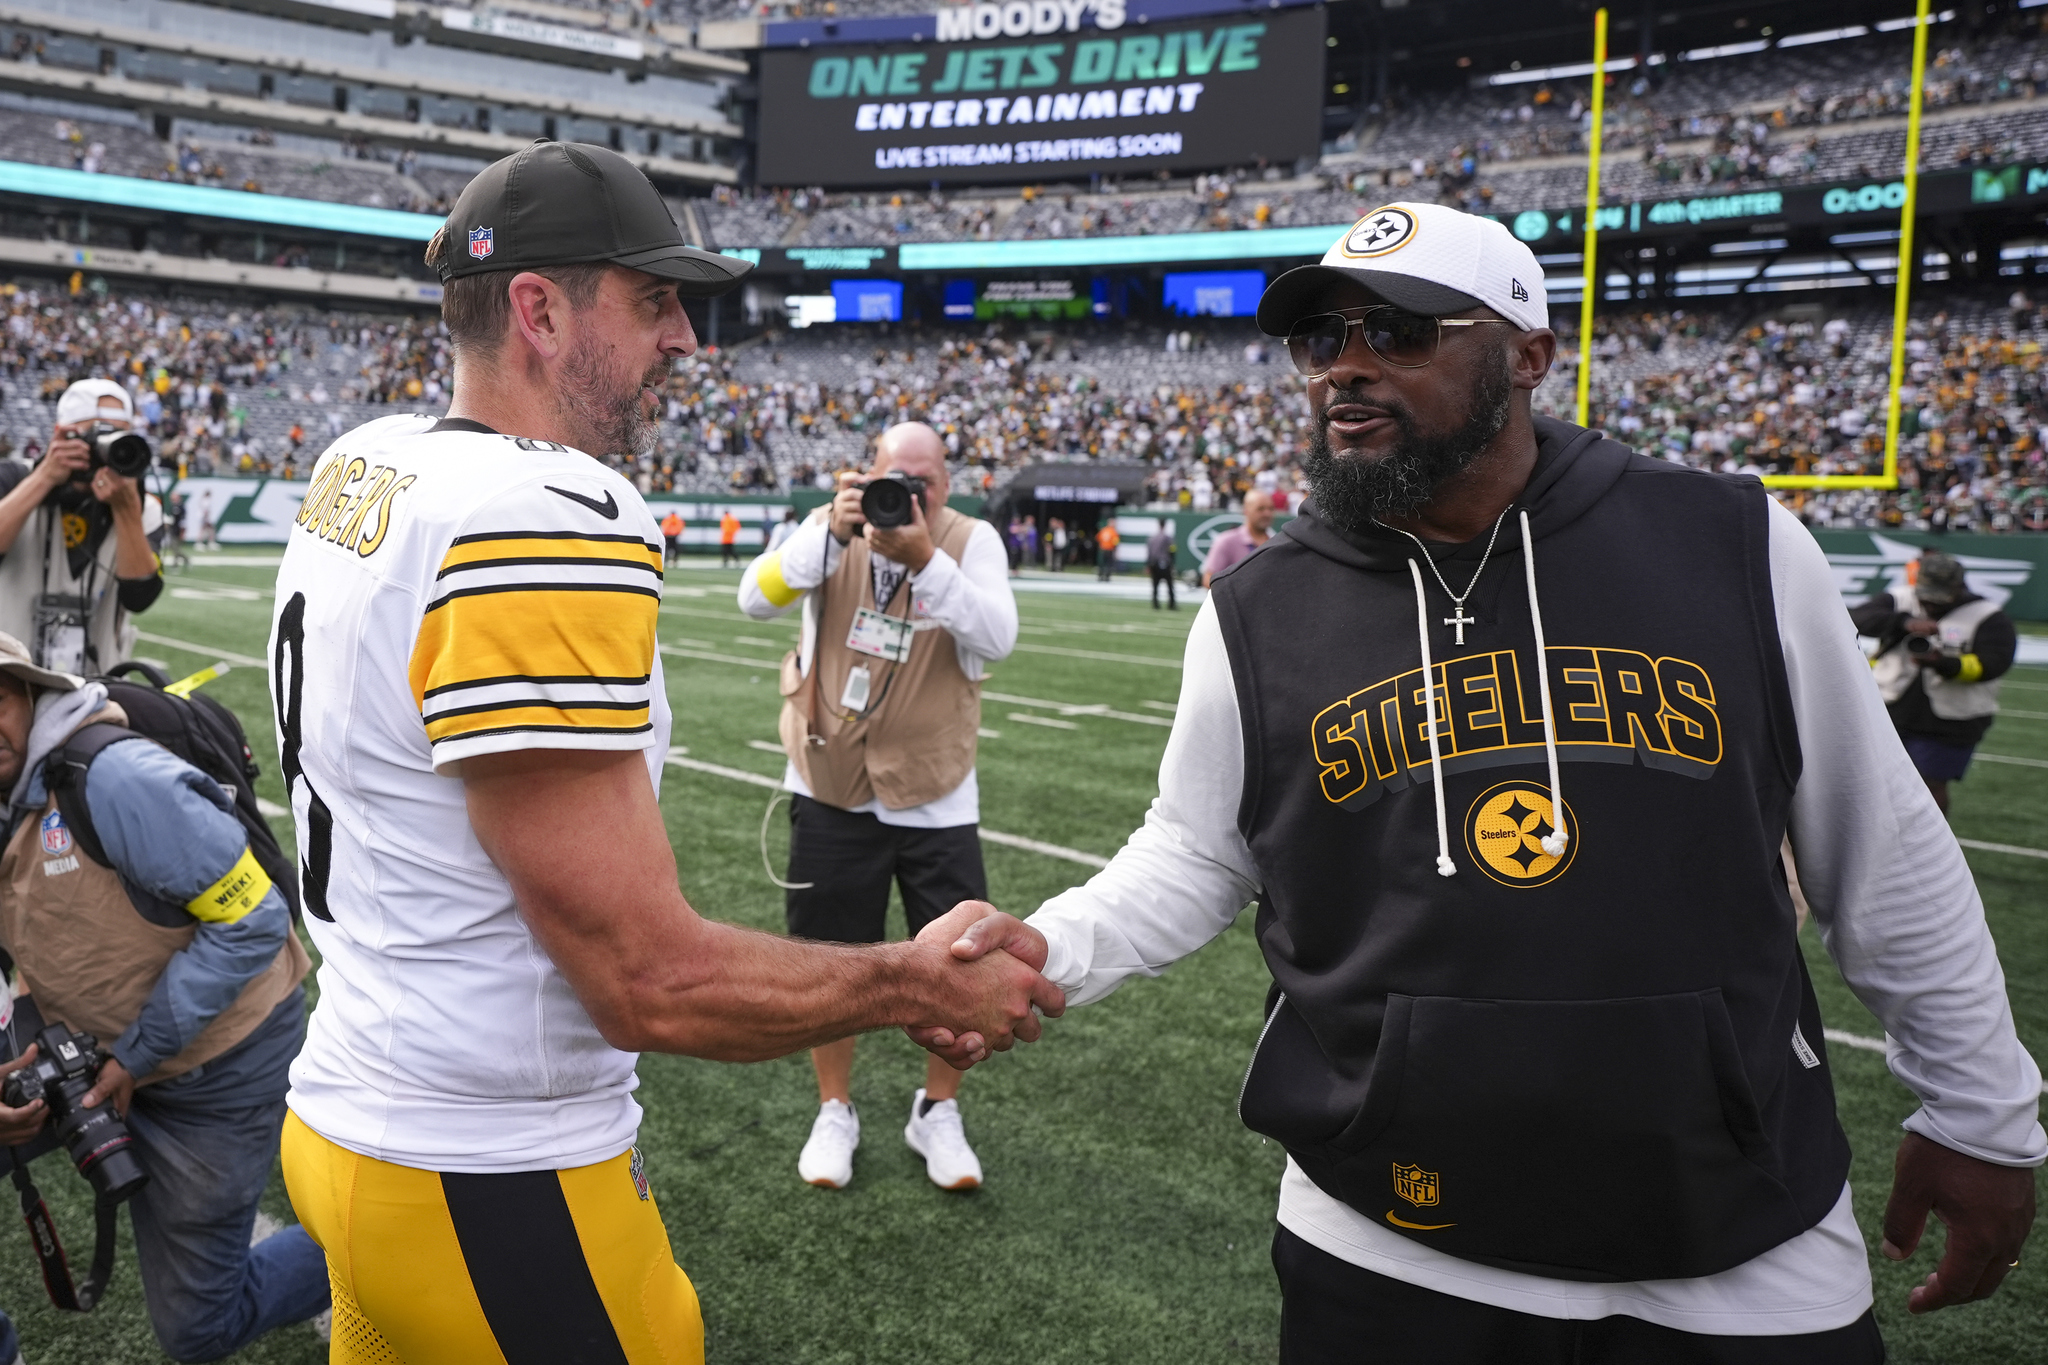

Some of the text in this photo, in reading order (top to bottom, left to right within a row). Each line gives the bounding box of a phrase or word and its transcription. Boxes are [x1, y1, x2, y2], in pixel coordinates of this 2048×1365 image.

[935, 0, 1127, 42] MOODY'S
[808, 23, 1267, 98] ONE JETS DRIVE
[855, 82, 1204, 131] ENTERTAINMENT
[875, 131, 1183, 169] LIVE STREAM STARTING SOON
[1687, 191, 1783, 224] QUARTER
[1822, 182, 1908, 214] 0:00
[472, 240, 491, 255] NFL
[1311, 646, 1723, 804] STEELERS
[45, 828, 67, 849] NFL
[1481, 829, 1516, 839] Steelers
[43, 854, 80, 877] MEDIA
[214, 876, 248, 905] WEEK
[1400, 1180, 1434, 1201] NFL
